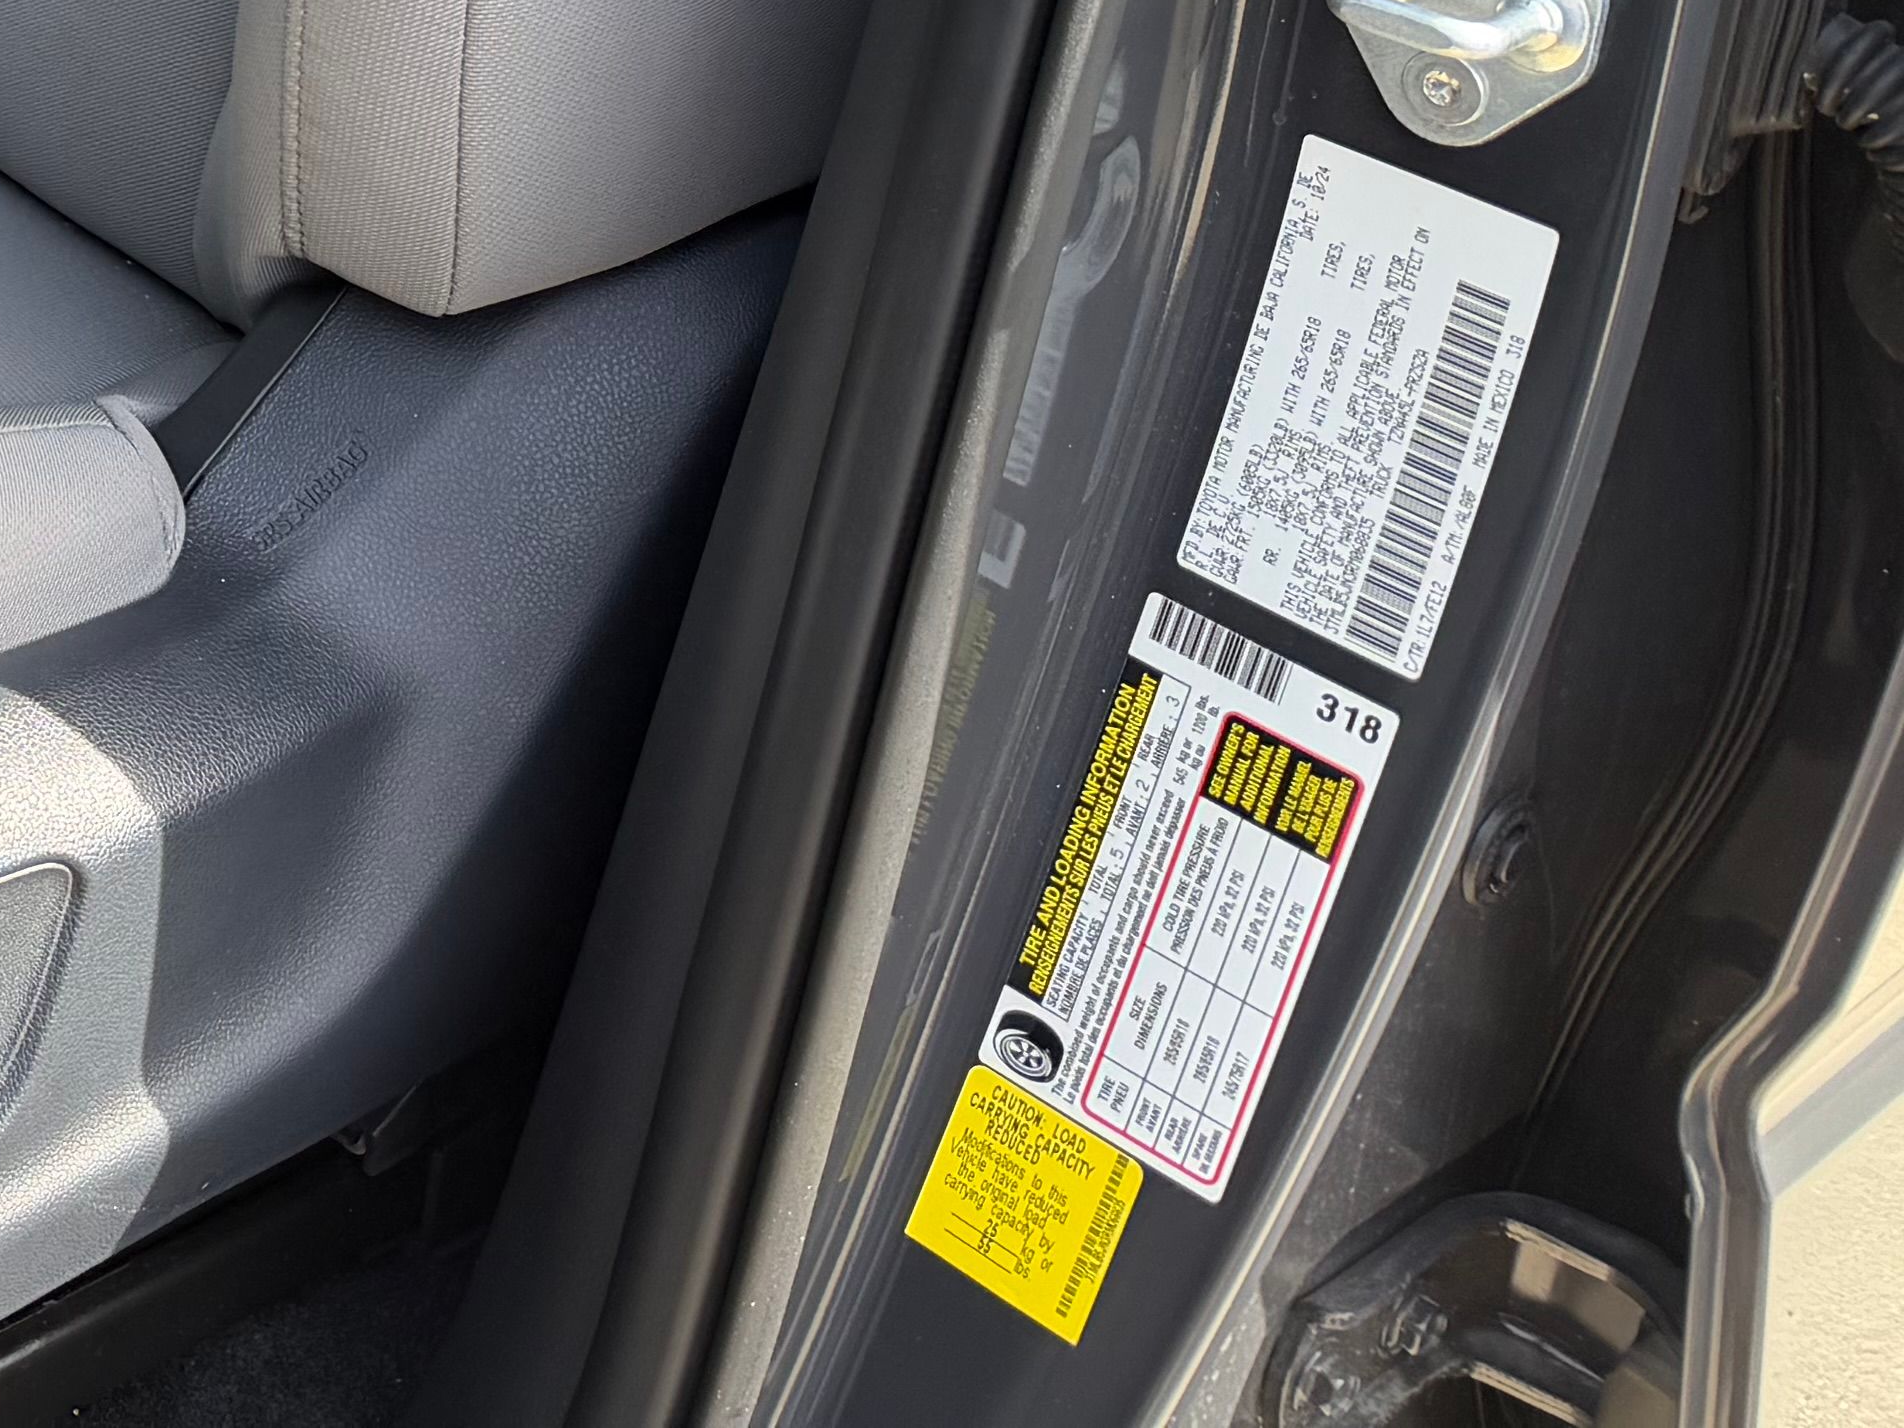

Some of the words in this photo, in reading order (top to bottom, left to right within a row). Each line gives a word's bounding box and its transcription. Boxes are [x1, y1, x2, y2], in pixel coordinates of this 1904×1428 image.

[1295, 170, 1314, 189] DE
[1298, 206, 1320, 242] DATE:
[1309, 164, 1331, 201] 10/24
[1268, 214, 1303, 288] CALIFORNIA,
[1413, 225, 1431, 244] ON
[1383, 253, 1406, 292] MOTOR
[1399, 245, 1425, 292] EFFECT
[1258, 290, 1280, 321] BAJA
[1367, 296, 1395, 346] FEDERAL
[1394, 293, 1412, 311] IN
[1252, 322, 1270, 341] DE
[1279, 381, 1301, 414] WITH
[1290, 315, 1322, 381] 265/65R18
[1320, 239, 1346, 279] TIRES,
[1308, 394, 1330, 427] WITH
[1319, 327, 1351, 394] 265/65R18
[1349, 251, 1375, 292] TIRES,
[1373, 313, 1405, 379] STANDARDS
[1504, 333, 1526, 359] 318
[1224, 342, 1264, 434] MANUFACTURING
[1344, 347, 1378, 420] APPLICABLE
[1376, 384, 1402, 427] ABOVE.
[1488, 367, 1515, 414] MEXICO
[1336, 423, 1355, 447] ALL
[1350, 381, 1385, 453] PREVENTION
[1482, 415, 1500, 433] IN
[1211, 434, 1235, 473] MOTOR
[1282, 425, 1304, 460] RIMS.
[1310, 438, 1333, 474] RIMS.
[1329, 448, 1346, 465] TO
[1362, 427, 1387, 467] SHOWN
[1471, 436, 1493, 469] MADE
[293, 439, 369, 525] AIRBAG
[1309, 467, 1339, 526] CONFORMS
[1337, 455, 1360, 492] THEFT
[1369, 461, 1393, 500] TRUCK
[1206, 519, 1223, 538] DE
[1328, 495, 1347, 520] AND
[1336, 468, 1374, 548] MANUFACTURE
[1290, 527, 1320, 580] VEHICLE
[1312, 521, 1338, 567] SAFETY
[1329, 548, 1346, 568] OF
[1279, 581, 1301, 612] THIS
[1293, 567, 1323, 622] VEHICLE
[1317, 568, 1340, 601] DATE
[1308, 602, 1329, 626] THE
[1115, 672, 1158, 759] CHARGEMENT
[1165, 694, 1180, 708] 3
[1315, 691, 1383, 745] 318
[1109, 756, 1127, 777] LE
[1216, 721, 1245, 775] OWNER'S
[1222, 755, 1251, 805] MANUAL
[1240, 730, 1260, 757] FOR
[1102, 773, 1121, 794] ET
[1134, 778, 1150, 792] 2
[1207, 773, 1226, 798] SEE
[1239, 742, 1274, 811] ADDITIONAL
[1253, 744, 1291, 824] INFORMATION
[1018, 923, 1046, 967] TIRE
[1035, 884, 1061, 927] AND
[1049, 804, 1091, 886] LOADING
[1079, 682, 1136, 806] INFORMATION
[1087, 791, 1114, 835] PNEUS
[1078, 832, 1099, 860] LES
[1109, 846, 1124, 860] 5
[1046, 962, 1070, 1008] SEATING
[1062, 911, 1089, 964] CAPACITY
[1087, 863, 1108, 894] TOTAL
[1112, 794, 1132, 829] FRONT
[1137, 732, 1155, 761] REAR
[1068, 857, 1090, 887] SUR
[1028, 884, 1080, 995] RENSEIGNEMENTS
[1051, 1076, 1066, 1097] The
[1059, 1028, 1084, 1078] combined
[1077, 994, 1098, 1031] weight
[1094, 933, 1121, 985] occupants
[1113, 912, 1128, 935] and
[1121, 885, 1139, 915] cargo
[1131, 850, 1151, 886] should
[1144, 823, 1161, 853] never
[1154, 788, 1174, 824] exceed
[1079, 916, 1102, 956] PLACES
[1074, 955, 1088, 972] DE
[1096, 1074, 1115, 1102] TIRE
[1128, 994, 1146, 1021] SIZE
[1161, 901, 1181, 932] COLD
[1172, 877, 1190, 902] TIRE
[1181, 823, 1210, 878] PRESSURE
[1057, 969, 1083, 1015] NOMBRE
[1109, 1081, 1129, 1113] PNEU
[1133, 980, 1167, 1050] DIMENSIONS
[1169, 905, 1196, 955] PRESSION
[968, 1091, 1031, 1140] CARRYING
[1033, 1132, 1095, 1181] CAPACITY
[983, 1119, 1041, 1166] REDUCED
[990, 1084, 1047, 1130] CAUTION:
[1051, 1122, 1087, 1155] LOAD
[948, 1136, 988, 1173] Vehicle
[990, 1165, 1019, 1193] have
[1022, 1187, 1069, 1225] reduced
[959, 1126, 1027, 1180] Modifications
[1030, 1173, 1043, 1191] to
[1047, 1184, 1068, 1207] this
[942, 1172, 986, 1211] carrying
[988, 1203, 1034, 1243] capacity
[1037, 1234, 1055, 1256] by
[956, 1162, 976, 1183] the
[978, 1177, 1020, 1213] original
[1021, 1204, 1048, 1230] load
[976, 1233, 993, 1254] 55
[1012, 1257, 1032, 1281] lbs.
[982, 1217, 999, 1238] 25
[1017, 1241, 1036, 1265] kg
[1039, 1257, 1053, 1273] or
